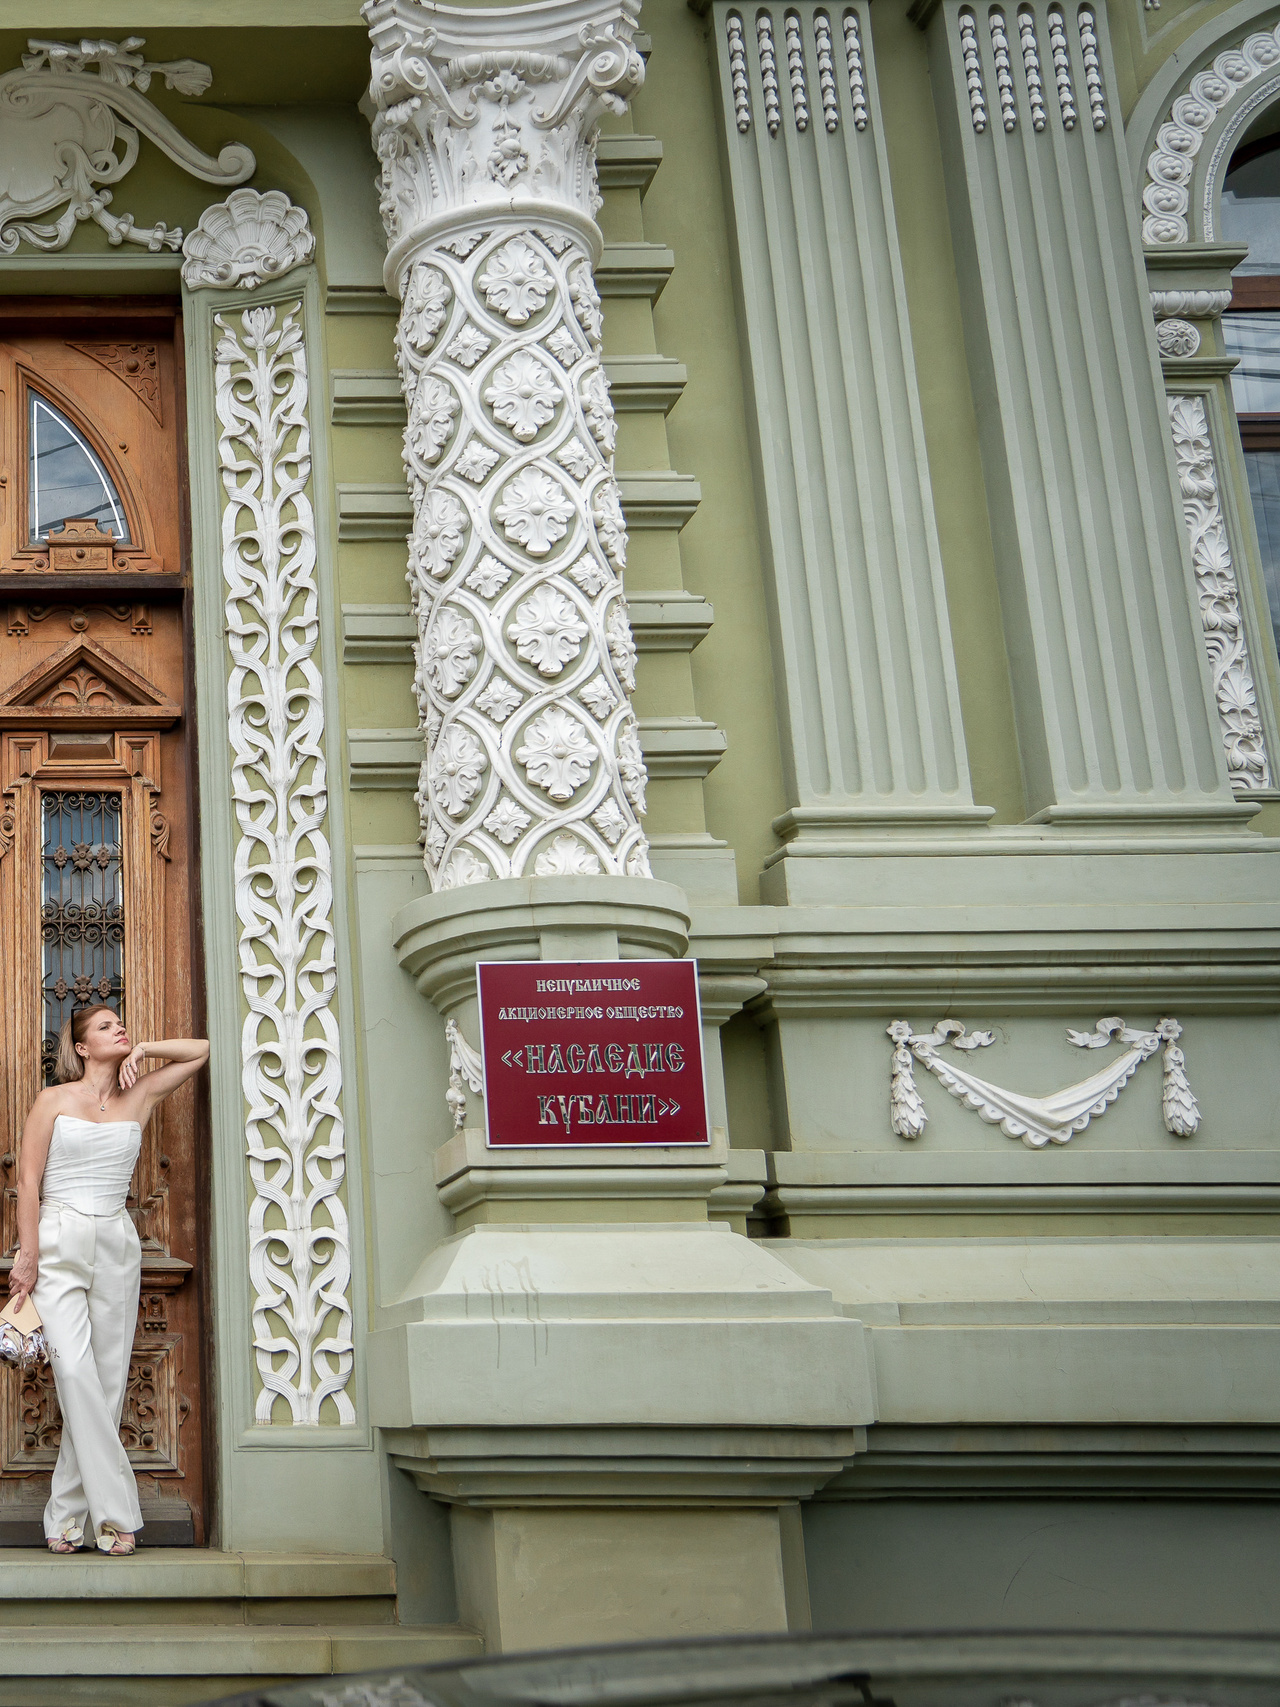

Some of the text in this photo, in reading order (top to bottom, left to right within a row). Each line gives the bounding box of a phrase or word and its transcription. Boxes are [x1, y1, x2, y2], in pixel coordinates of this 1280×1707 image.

[536, 978, 640, 995] НЕПУБЛИЧНОЕ
[499, 1006, 684, 1022] АКЦИОНЕРНОЕ ОБЩЕСТВО
